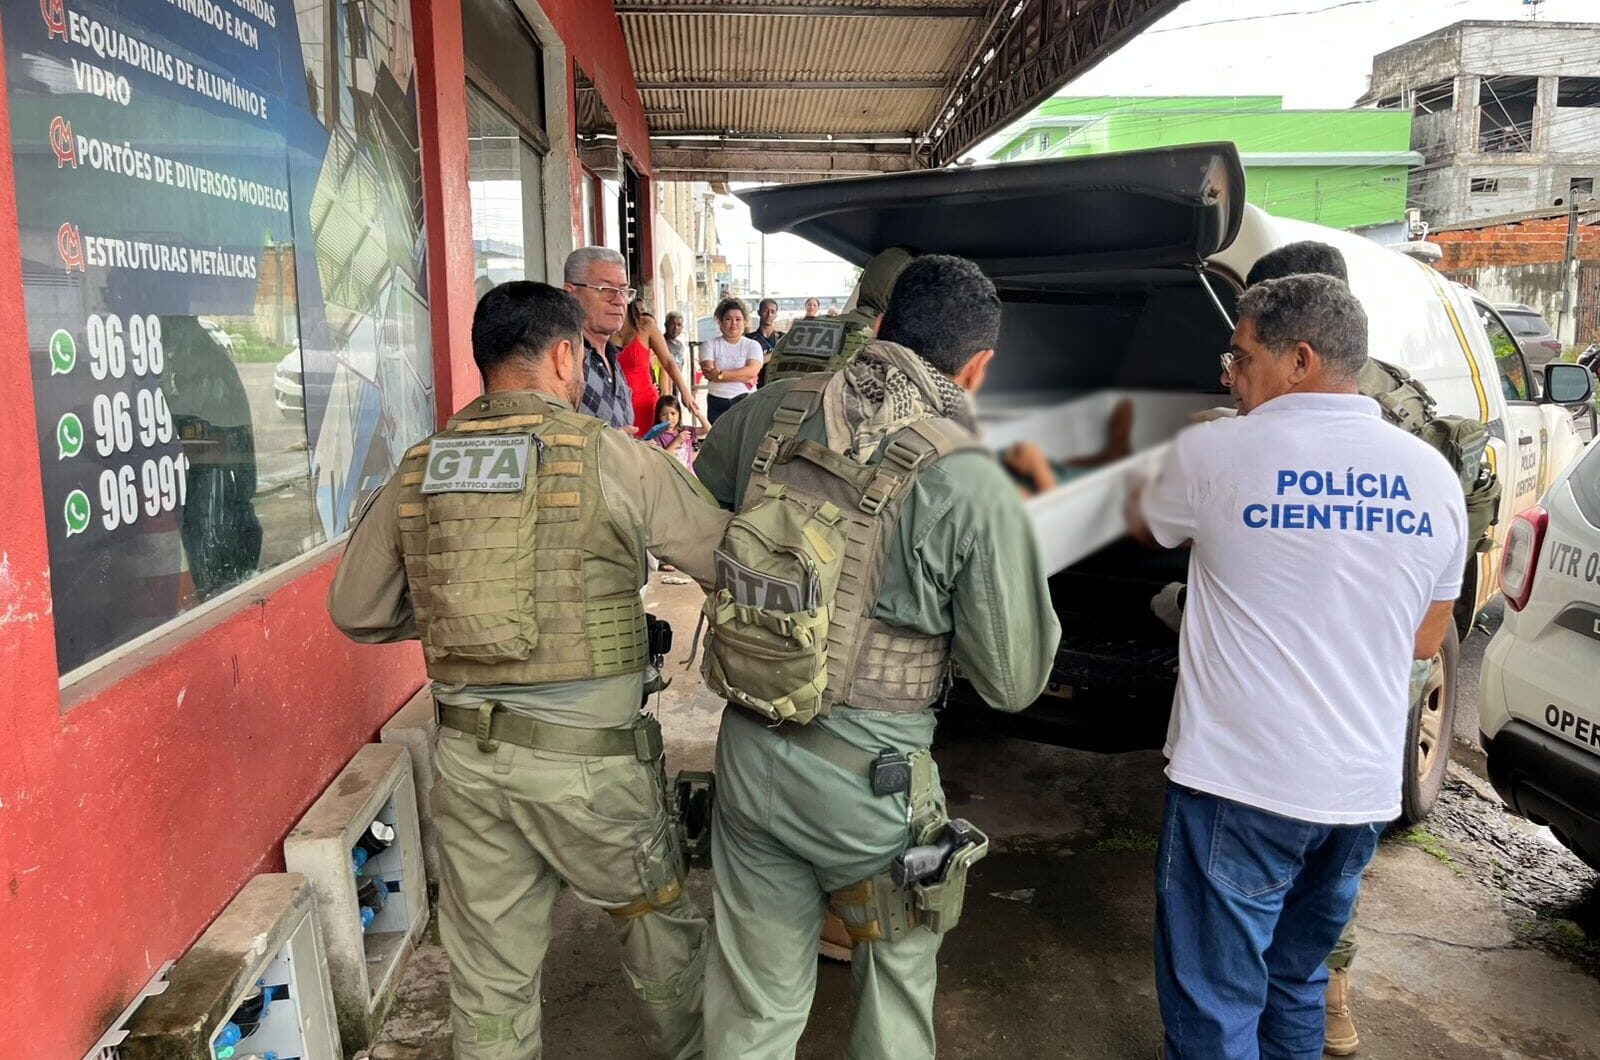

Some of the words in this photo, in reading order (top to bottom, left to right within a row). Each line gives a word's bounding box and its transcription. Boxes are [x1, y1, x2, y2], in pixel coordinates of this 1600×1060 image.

[225, 11, 233, 36] E
[235, 17, 259, 50] ACM
[68, 10, 174, 82] ESQUADRIAS
[176, 58, 195, 90] DE
[197, 69, 259, 116] ALUMÍNIO
[260, 96, 267, 120] E
[71, 58, 131, 106] VIDRO
[76, 135, 152, 181] PORTÕES
[154, 156, 174, 186] DE
[175, 161, 237, 201] DIVERSOS
[239, 178, 288, 212] MODELOS
[85, 236, 188, 273] ESTRUTURAS
[190, 246, 257, 279] METÁLICAS
[86, 314, 126, 380] 96
[129, 314, 164, 376] 98
[789, 326, 834, 350] GTA
[93, 391, 133, 457] 96
[430, 448, 521, 481] GTA
[1277, 467, 1411, 500] POLÍCIA
[100, 464, 139, 531] 96
[1243, 500, 1433, 537] CIENTÍFICA
[1549, 541, 1582, 578] VTR
[1585, 552, 1600, 585] 0
